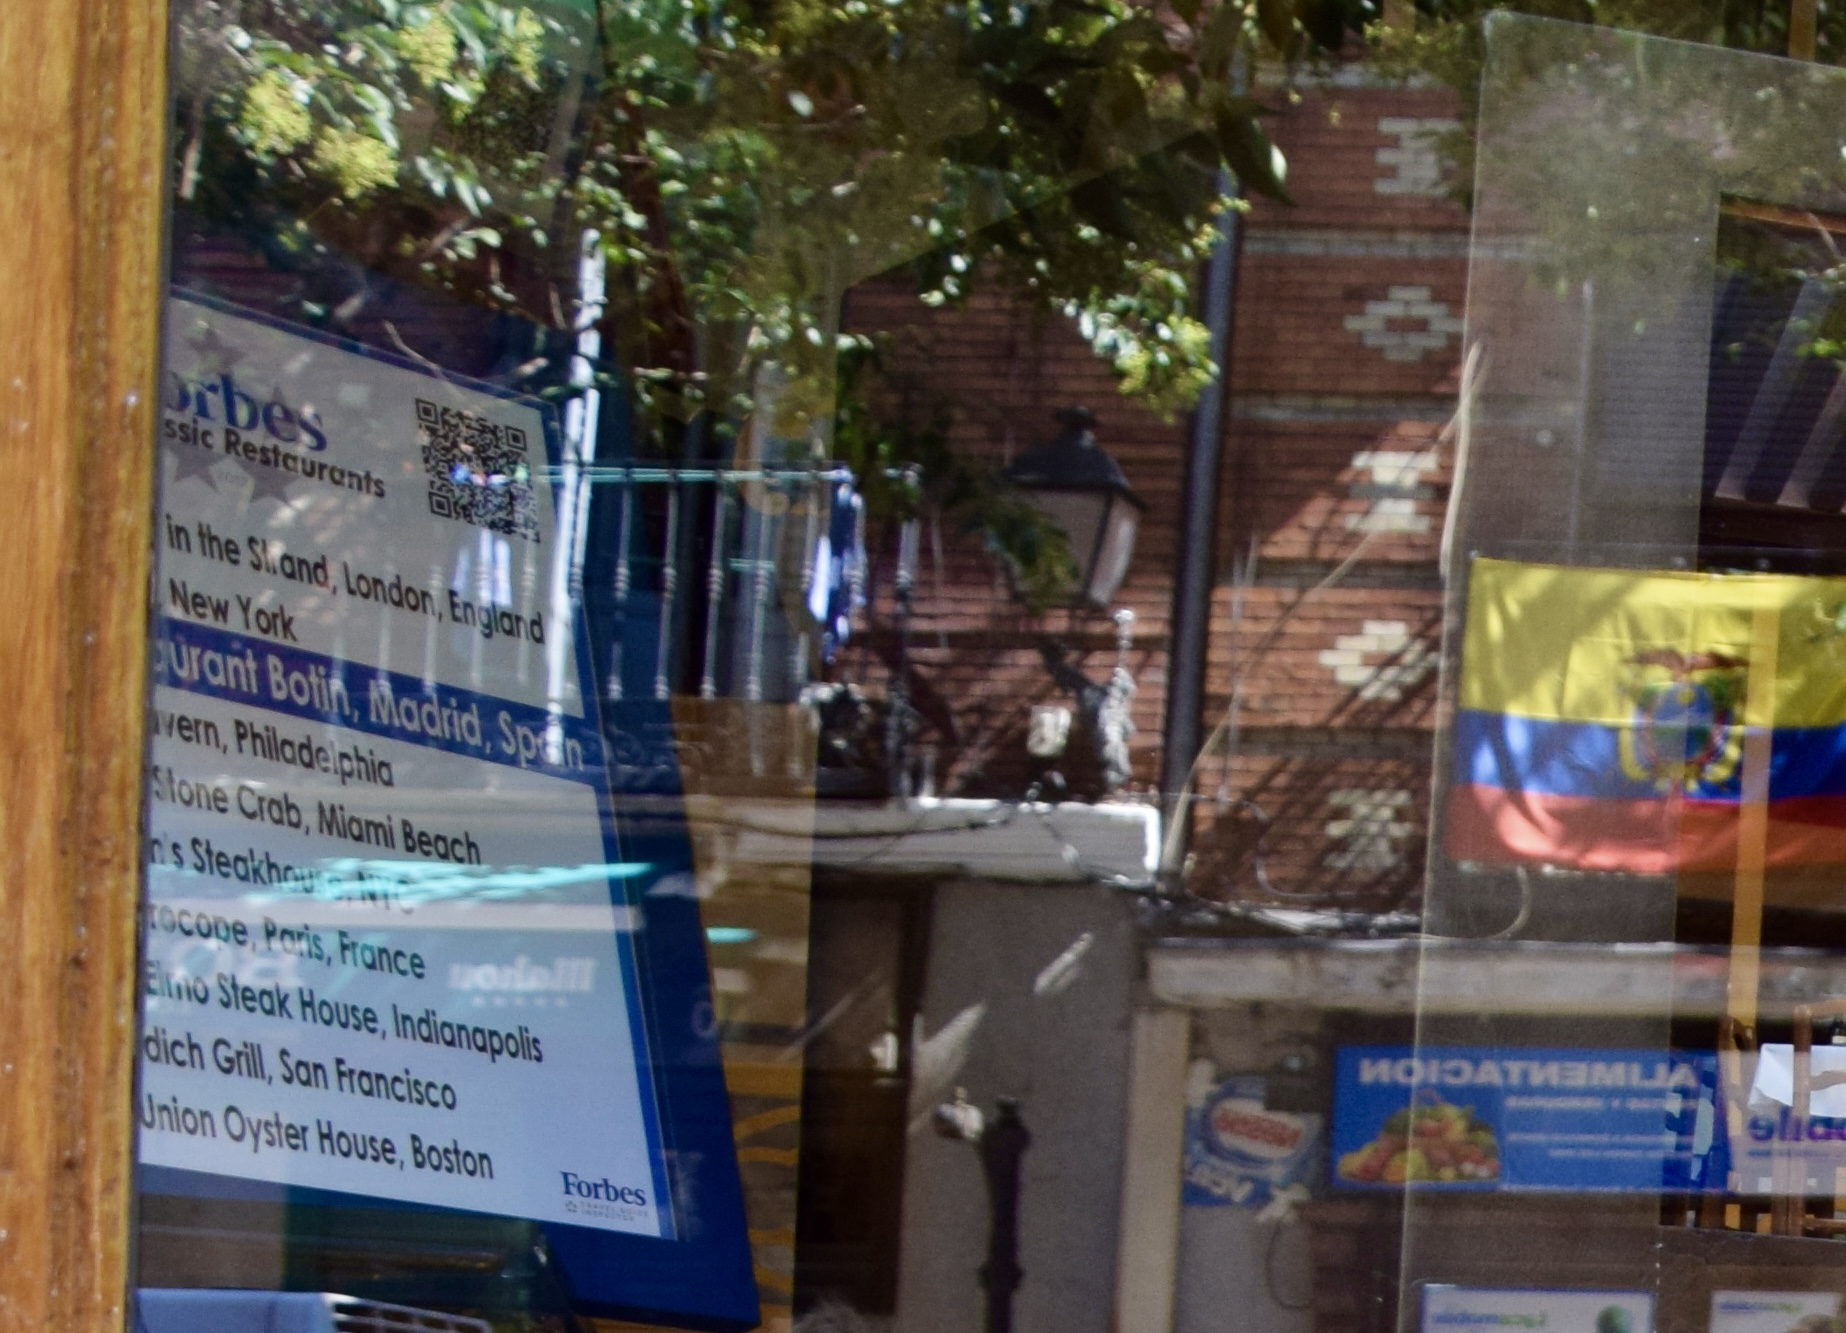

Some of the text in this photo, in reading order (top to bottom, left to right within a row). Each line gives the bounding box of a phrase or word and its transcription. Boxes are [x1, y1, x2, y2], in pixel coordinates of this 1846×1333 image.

[224, 427, 387, 498] Restaurants
[166, 513, 192, 552] in
[198, 521, 241, 565] the
[343, 561, 443, 623] London,
[448, 589, 545, 644] England
[169, 578, 298, 642] New York
[234, 718, 395, 787] Philadelphia
[369, 679, 491, 754] Madrid,
[498, 711, 584, 771] Spn
[237, 785, 311, 837] Crab,
[318, 800, 397, 851] Miami
[401, 819, 482, 867] Beach
[263, 915, 332, 967] Paris,
[337, 930, 425, 980] France
[216, 972, 293, 1020] Steak
[299, 986, 387, 1041] House,
[392, 1003, 543, 1063] Indianapolis
[212, 1036, 273, 1086] Grill,
[278, 1048, 329, 1091] San
[335, 1056, 457, 1112] Francisco
[224, 1104, 310, 1157] Oyster
[317, 1120, 404, 1171] House,
[410, 1131, 494, 1181] Boston
[559, 1170, 647, 1206] Forbes
